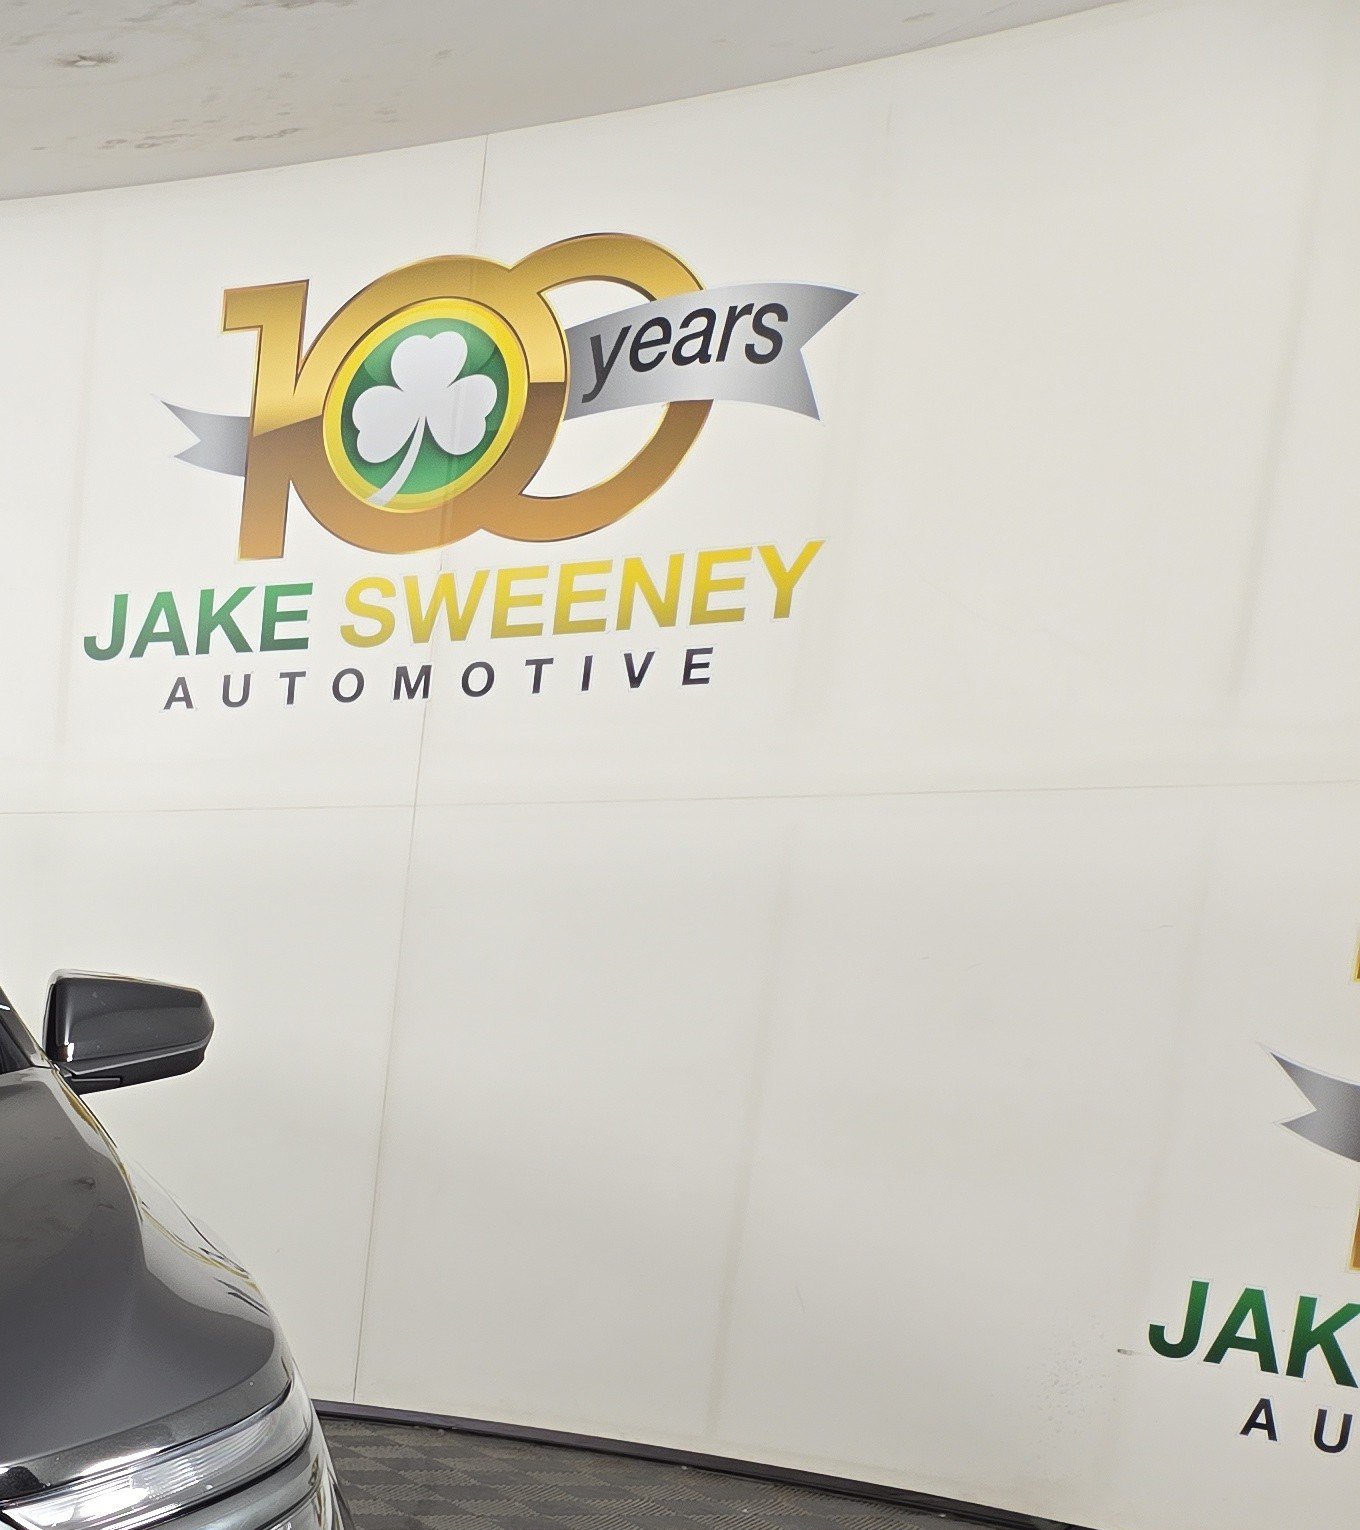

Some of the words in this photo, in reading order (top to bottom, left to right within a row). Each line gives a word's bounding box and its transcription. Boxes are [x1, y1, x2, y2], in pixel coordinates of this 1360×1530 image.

[580, 301, 788, 404] years
[84, 582, 312, 661] JAKE
[340, 540, 824, 648] SWEENEY
[163, 647, 714, 710] AUTOMOTIVE
[1148, 1280, 1360, 1388] JAK
